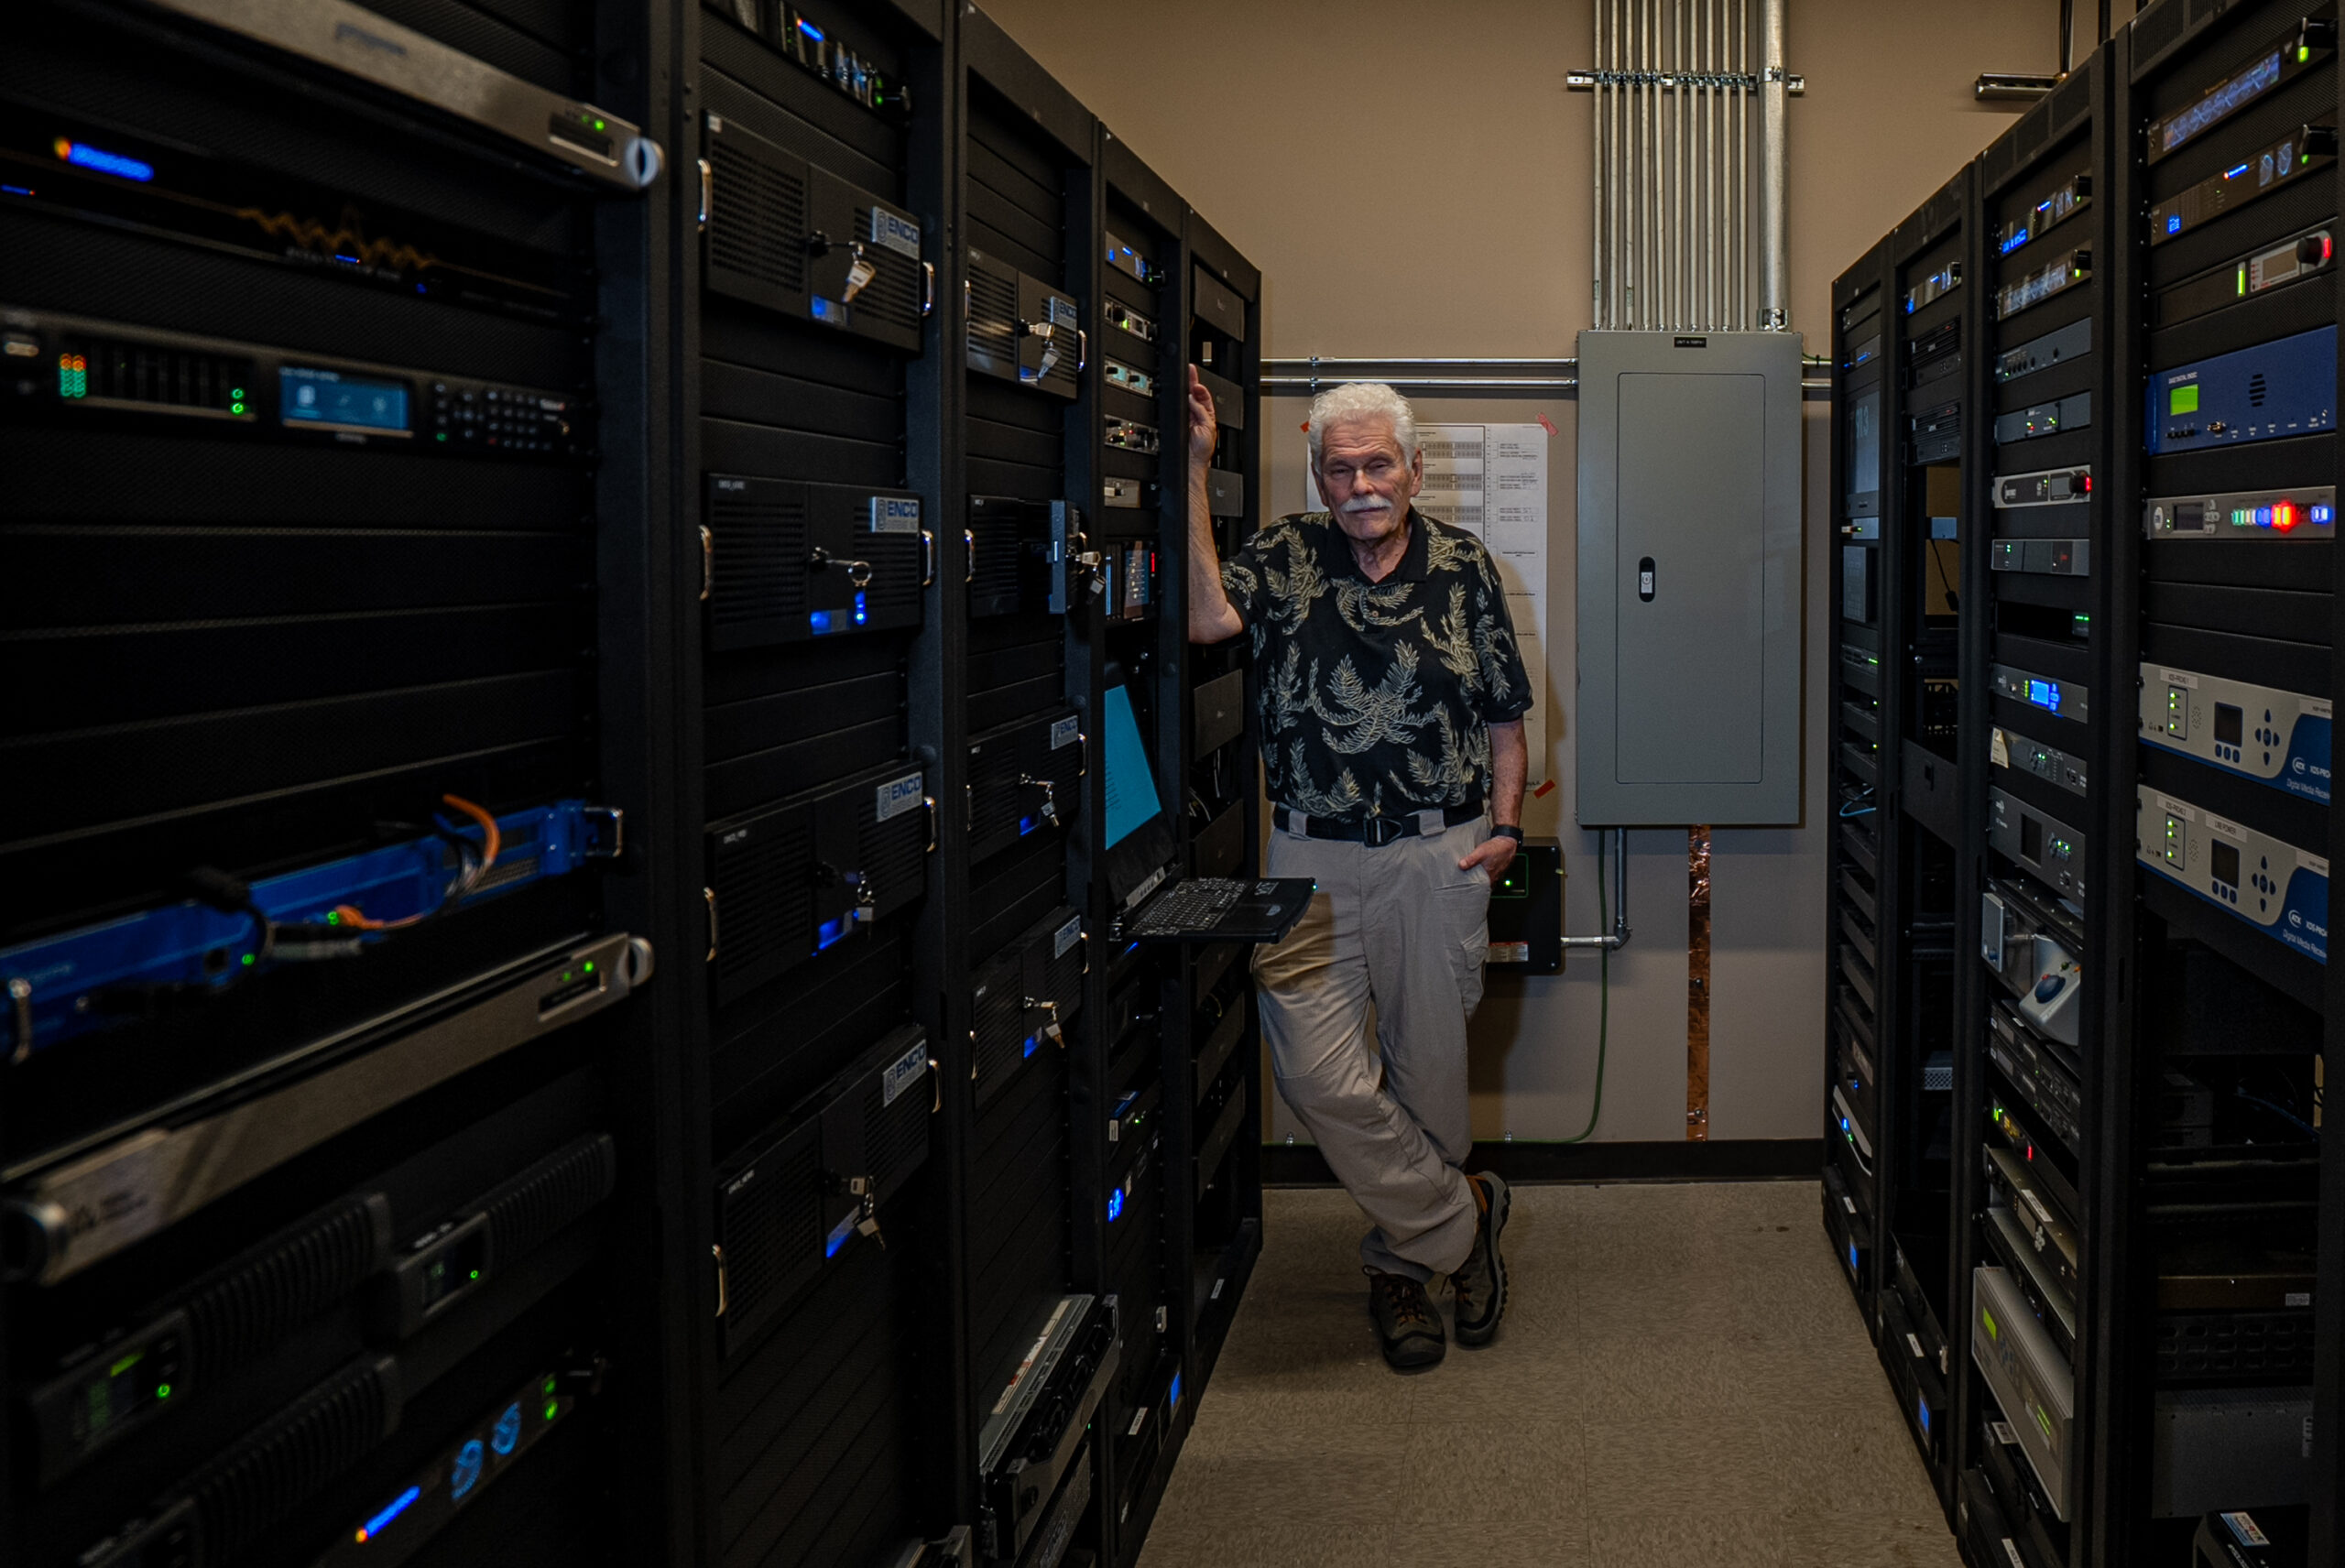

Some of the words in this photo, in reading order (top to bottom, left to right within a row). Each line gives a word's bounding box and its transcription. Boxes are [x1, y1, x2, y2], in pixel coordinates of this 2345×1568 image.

[888, 216, 919, 244] ENCO
[1059, 300, 1077, 319] ENCO
[887, 500, 918, 517] ENCO
[1060, 718, 1078, 734] ENCO
[891, 776, 922, 800] ENCO
[896, 1043, 926, 1080] ENCO
